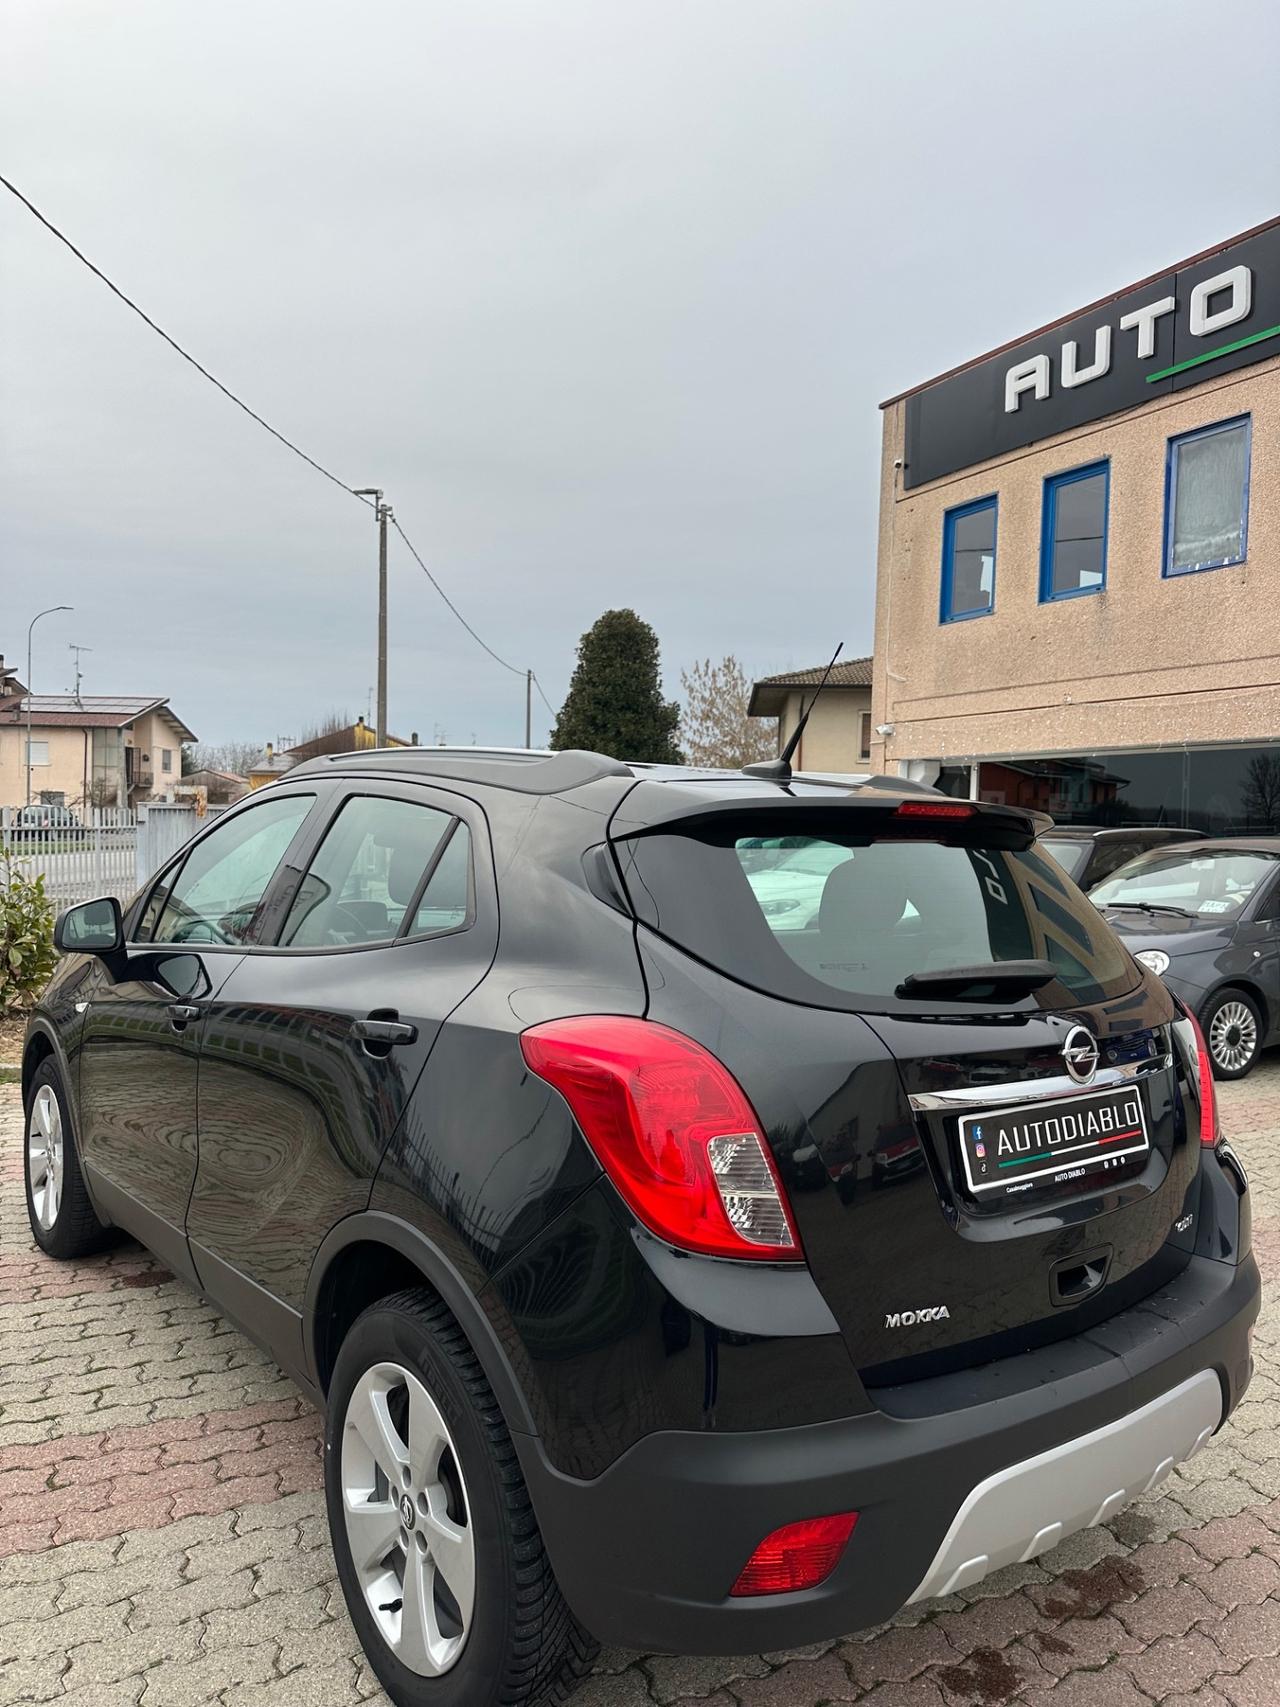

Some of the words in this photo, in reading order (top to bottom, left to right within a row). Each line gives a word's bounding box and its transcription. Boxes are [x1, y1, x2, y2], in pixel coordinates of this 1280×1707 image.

[1004, 264, 1252, 414] AUTO
[996, 1101, 1140, 1156] AUTODIABLO
[1054, 1173, 1068, 1183] AUTO
[1068, 1167, 1086, 1179] DIABLO
[884, 1305, 951, 1329] MOKKA
